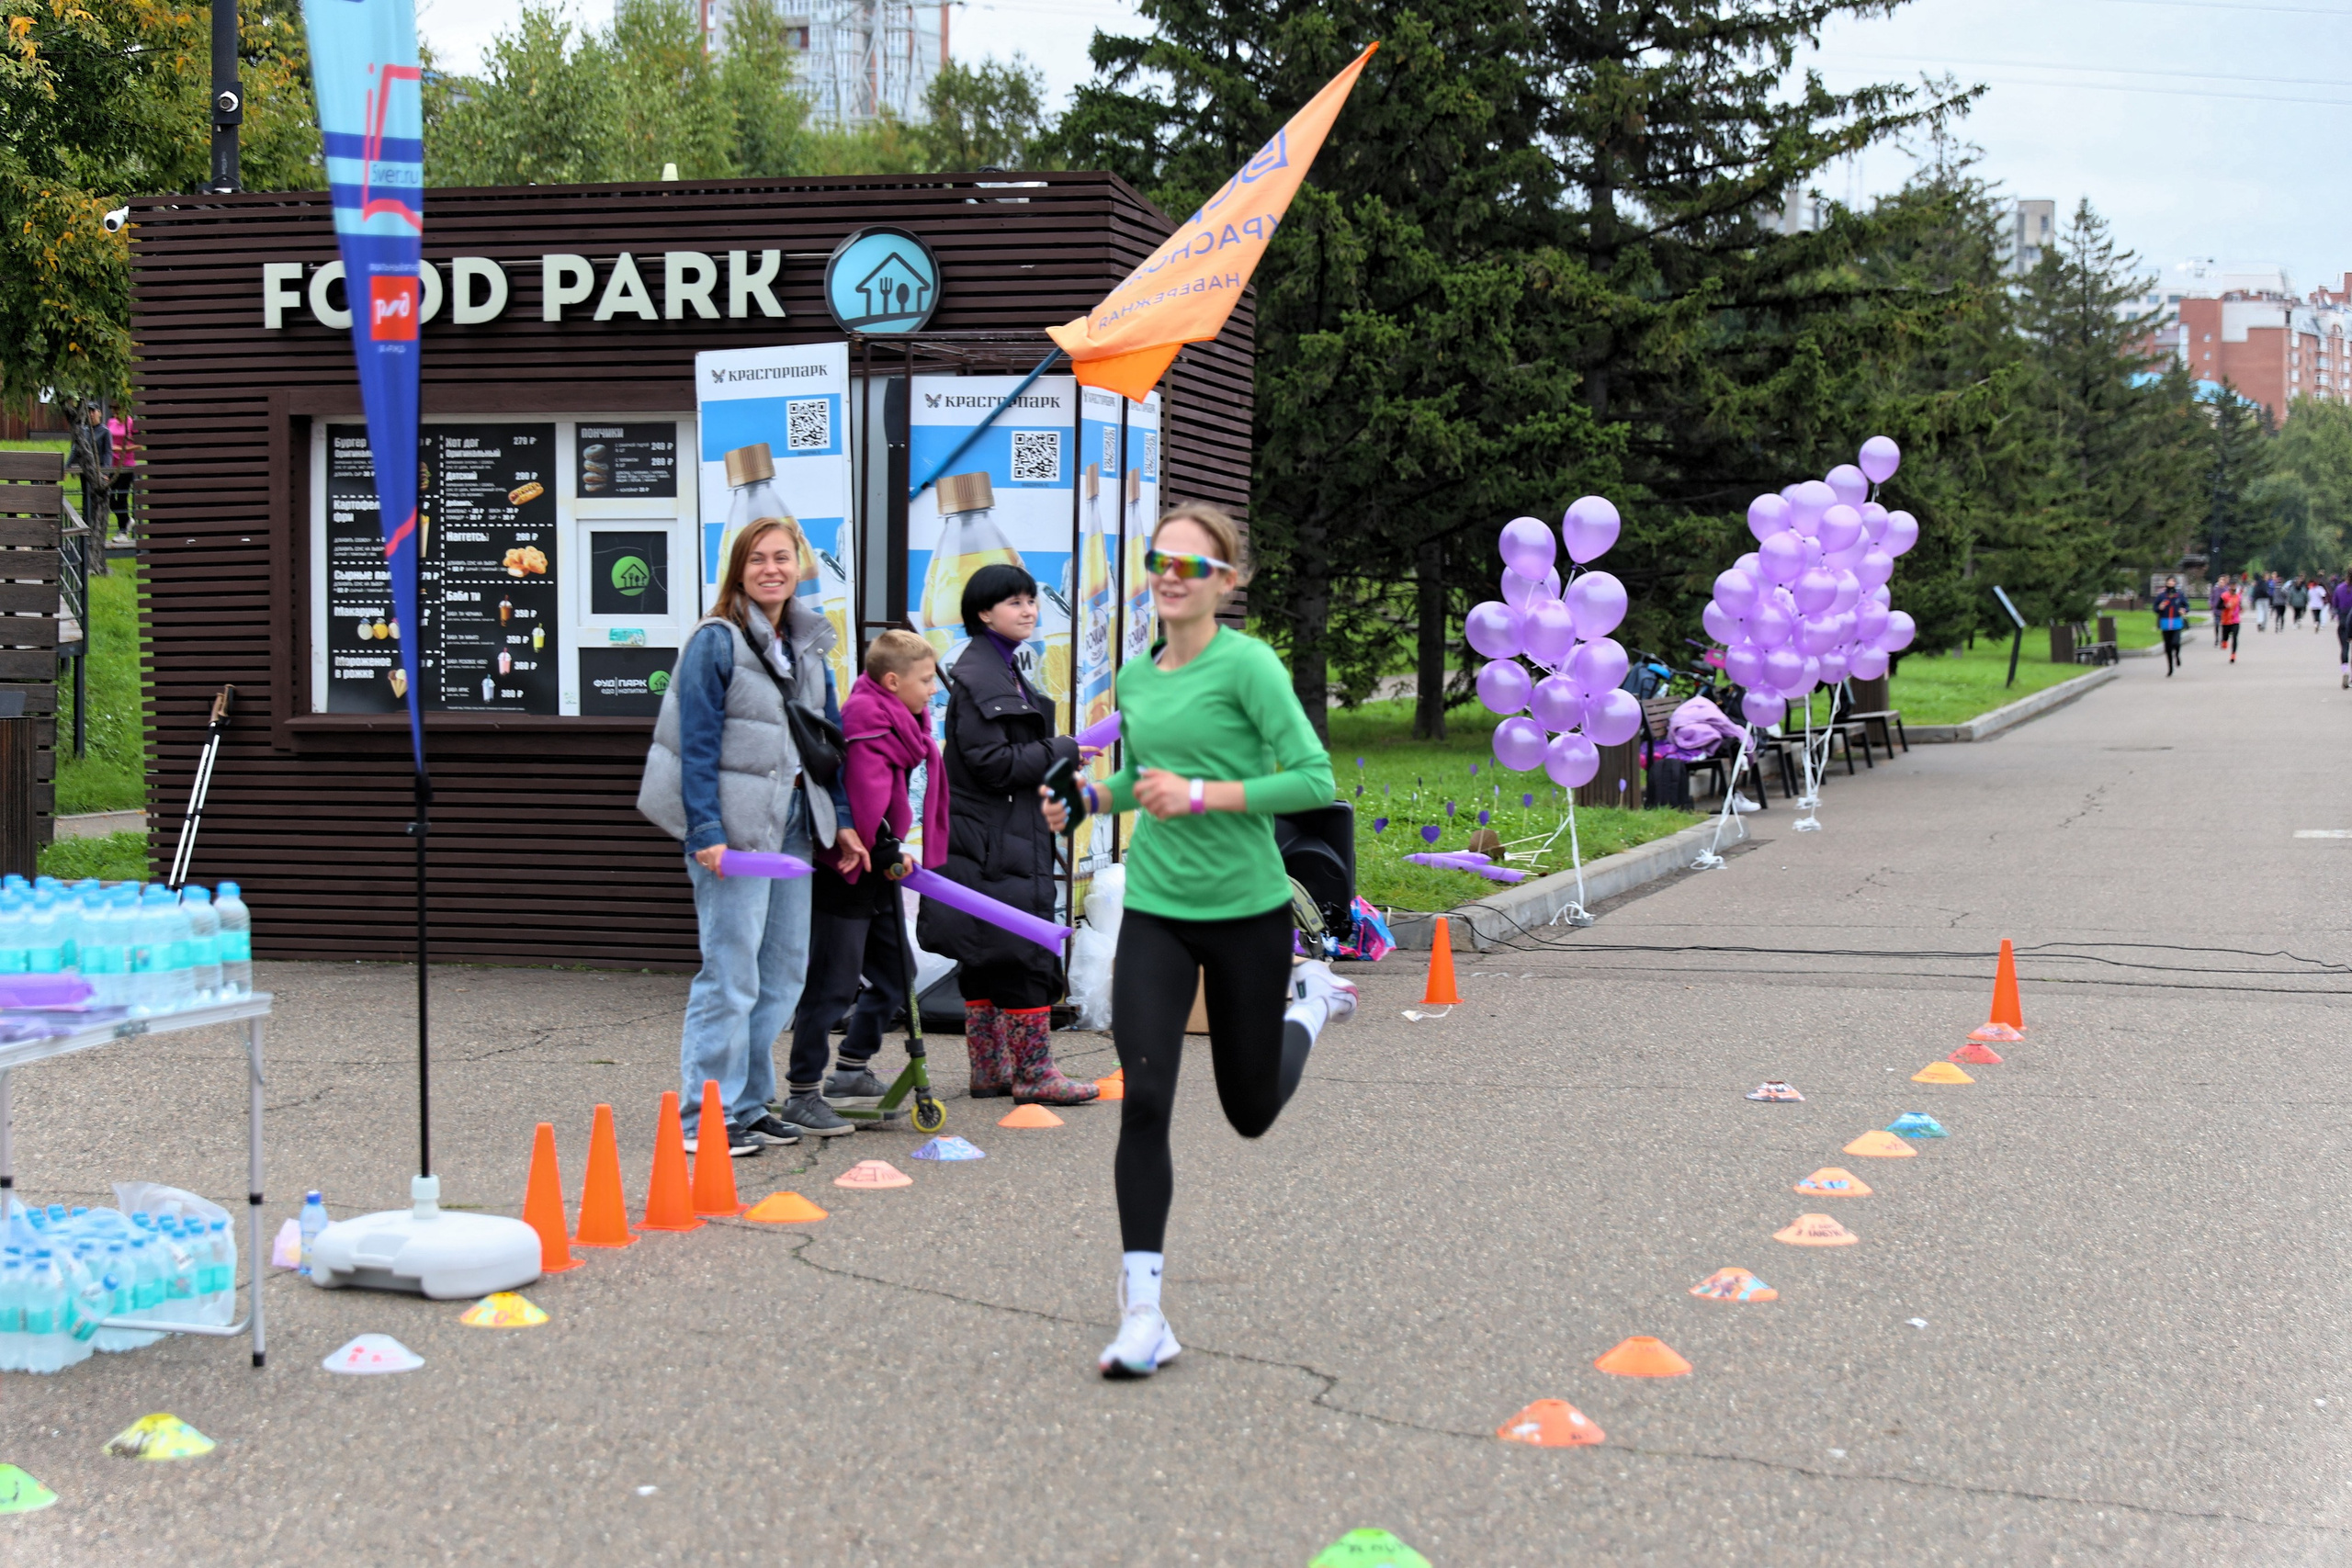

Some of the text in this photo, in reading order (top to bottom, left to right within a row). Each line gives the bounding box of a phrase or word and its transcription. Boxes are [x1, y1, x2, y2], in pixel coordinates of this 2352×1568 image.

[543, 250, 787, 322] PARK
[581, 428, 624, 438] ПОНЧИКИ
[334, 438, 367, 448] Бургер
[446, 438, 461, 447] Хот
[463, 438, 480, 448] дог
[334, 513, 354, 523] фри
[447, 532, 490, 542] Наггетсы
[334, 570, 373, 581] Сырные
[447, 591, 481, 602] Бабл ти
[334, 606, 385, 617] Макаруны
[334, 657, 391, 667] Мороженое
[344, 670, 374, 679] рожке
